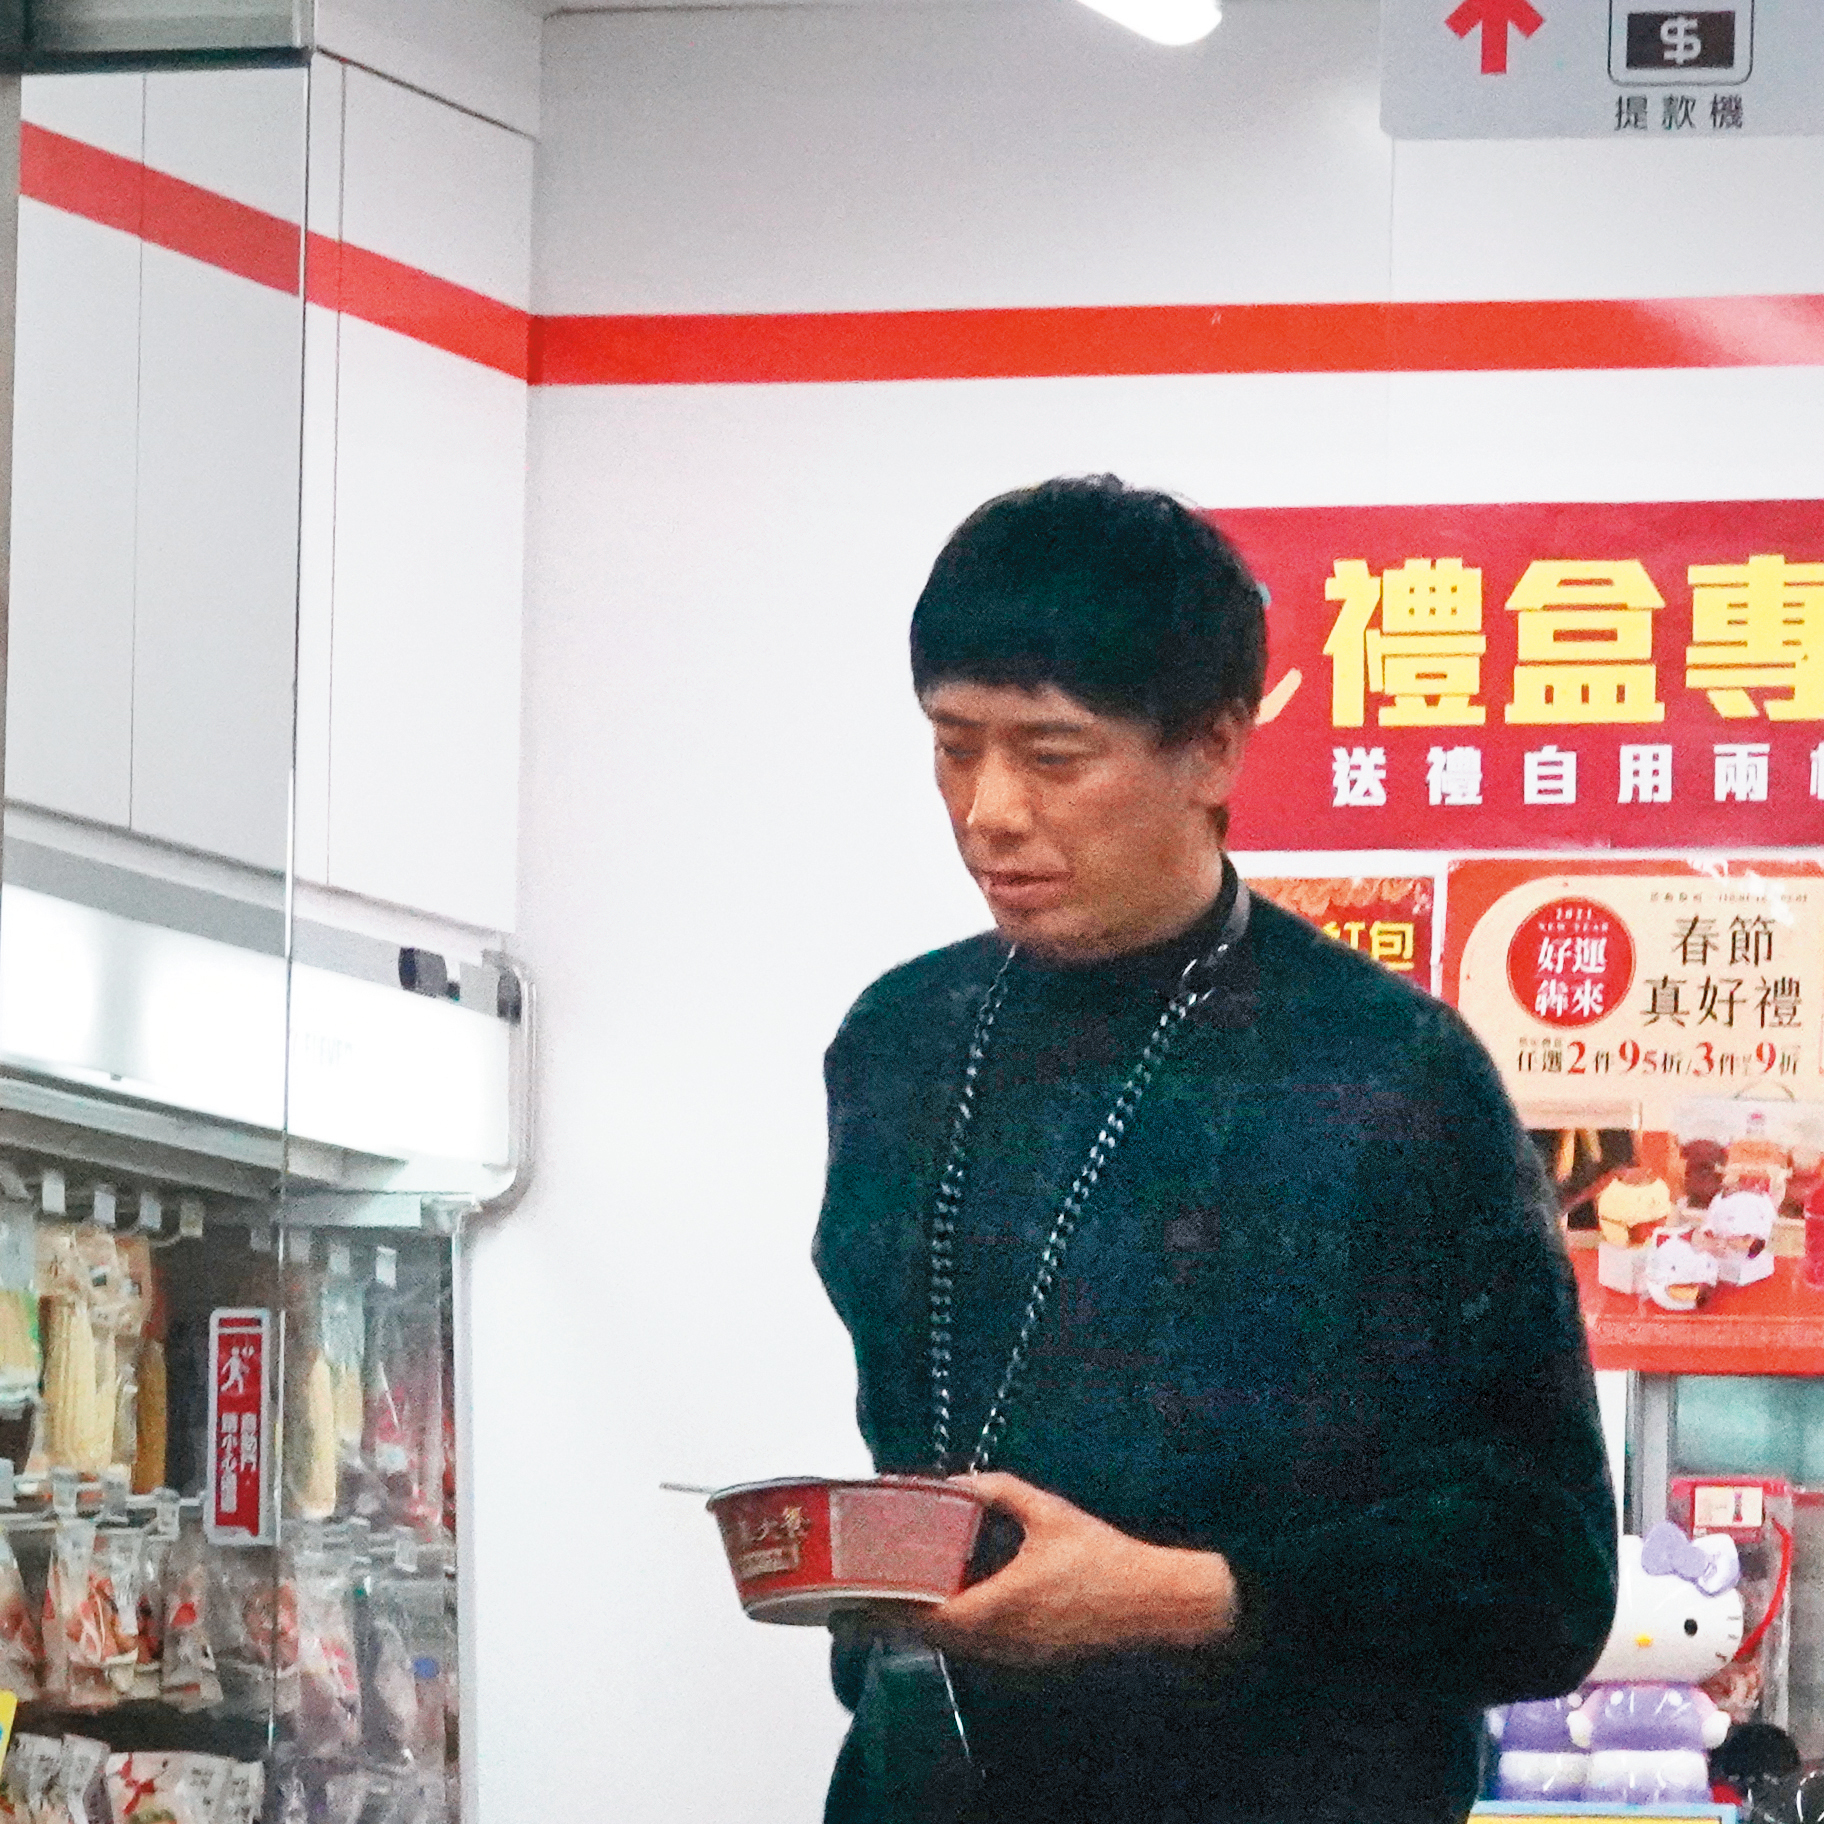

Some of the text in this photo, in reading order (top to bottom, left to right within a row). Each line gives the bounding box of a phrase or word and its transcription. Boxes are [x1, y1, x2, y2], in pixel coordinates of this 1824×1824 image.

[1613, 92, 1746, 131] 提款機
[1537, 936, 1607, 974] 好運
[1673, 914, 1777, 969] 春節
[1639, 975, 1803, 1029] 真好禮
